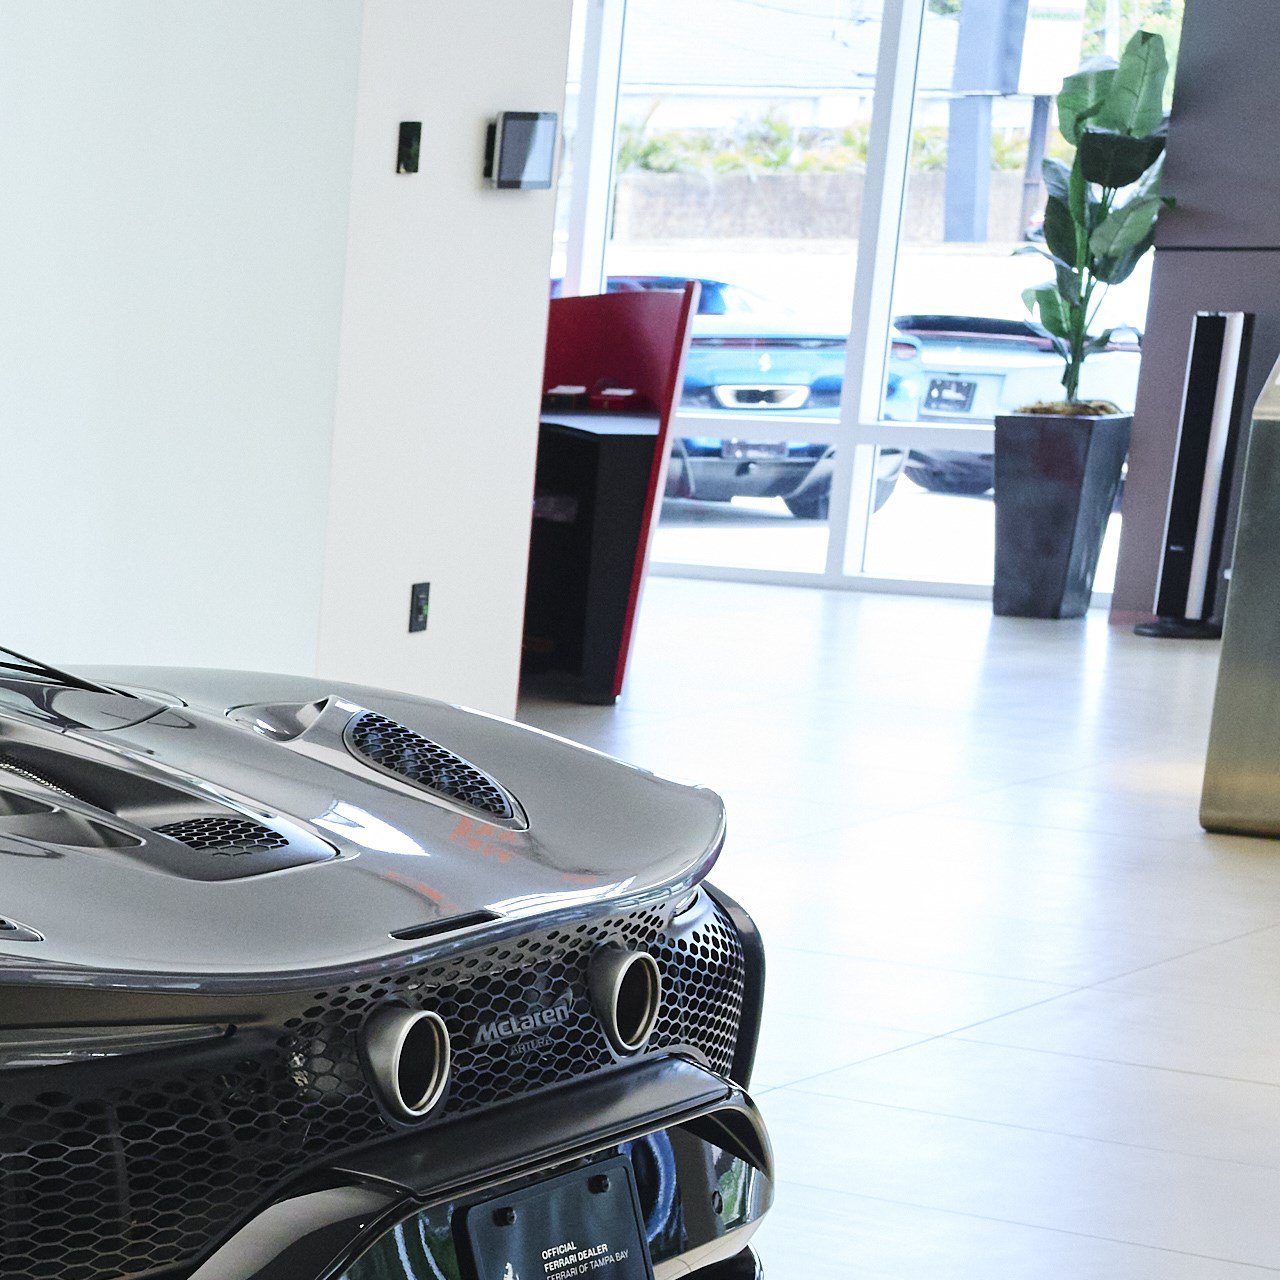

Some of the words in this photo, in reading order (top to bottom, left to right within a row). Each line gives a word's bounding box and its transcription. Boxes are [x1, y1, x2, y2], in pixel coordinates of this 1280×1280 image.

[474, 1005, 570, 1046] McLaren
[510, 1036, 554, 1056] ARTURA
[541, 1241, 577, 1260] OFFICIAL
[544, 1254, 578, 1272] FERRARI
[578, 1243, 608, 1261] DEALER
[579, 1262, 589, 1274] OF
[589, 1254, 616, 1270] TAMPA
[615, 1249, 629, 1262] BAY
